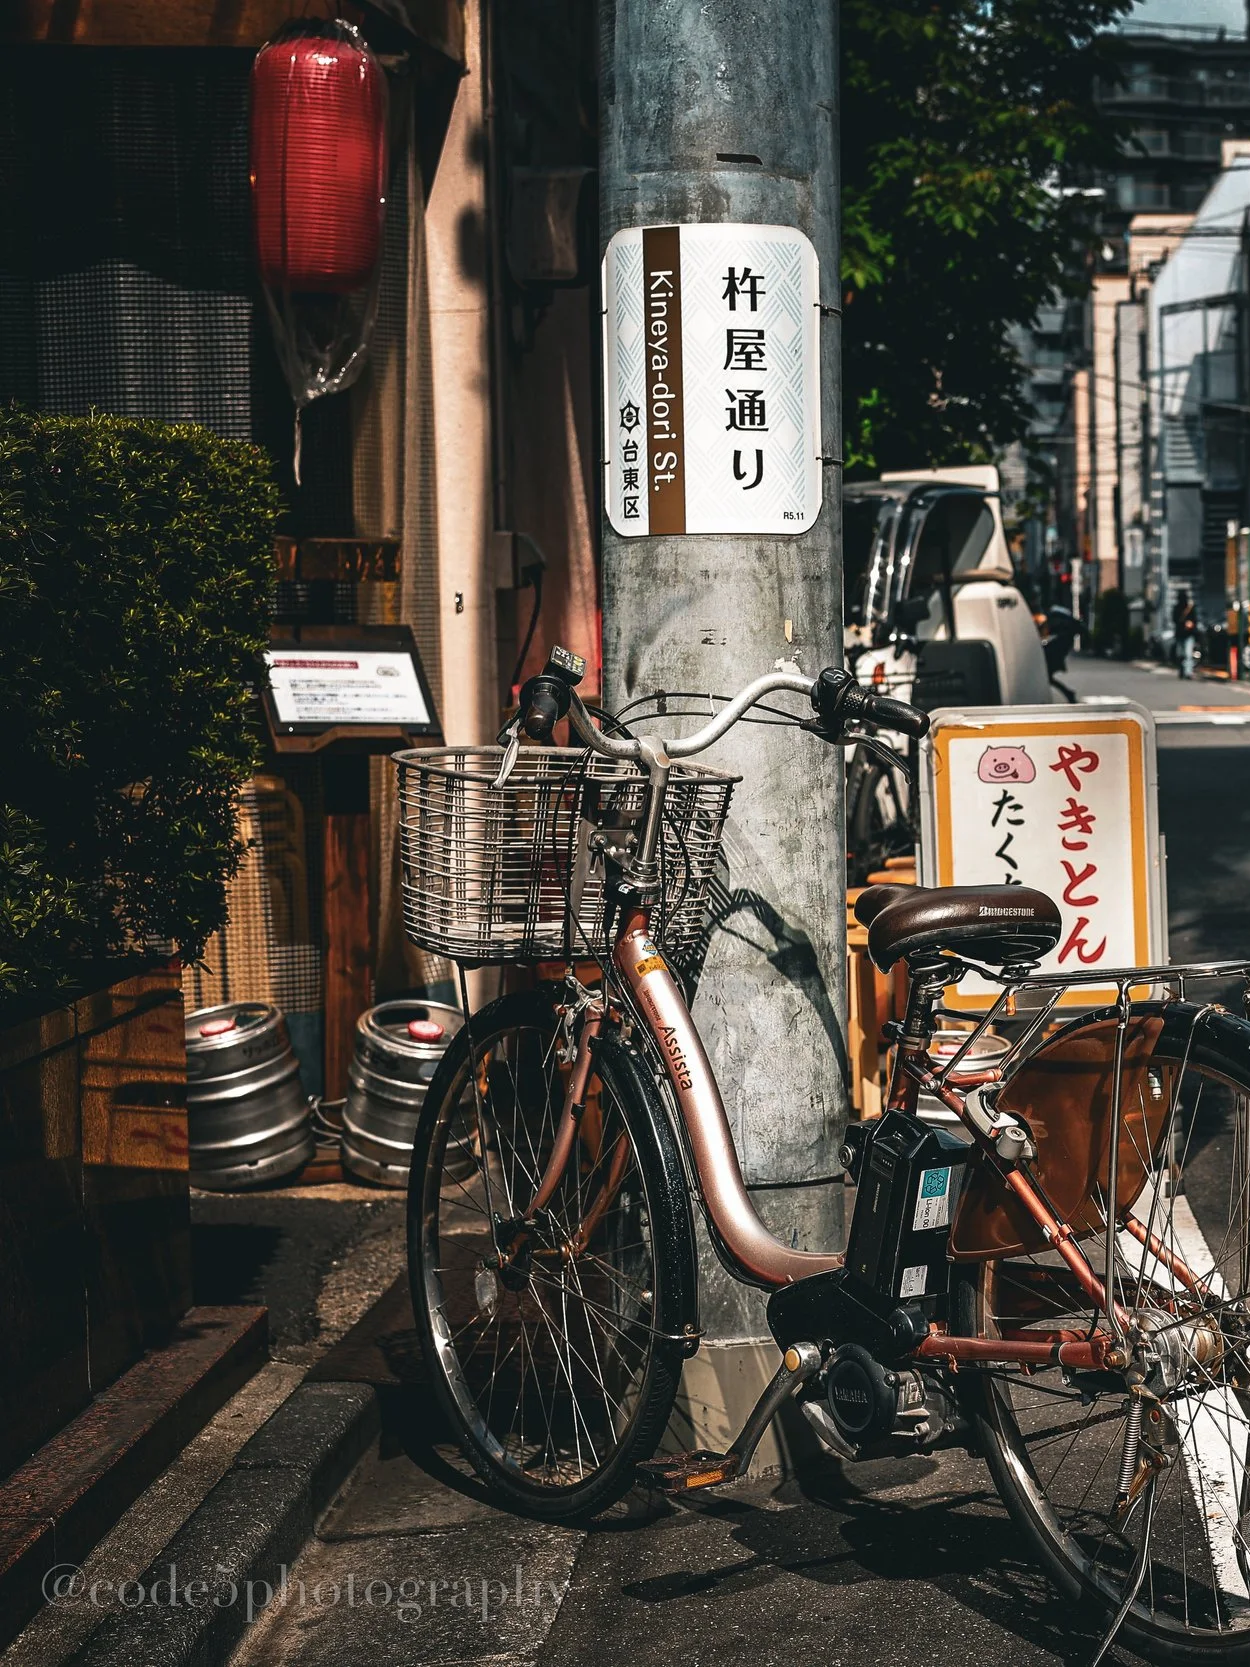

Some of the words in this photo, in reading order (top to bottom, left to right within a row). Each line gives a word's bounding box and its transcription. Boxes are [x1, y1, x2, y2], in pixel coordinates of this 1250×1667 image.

[648, 270, 676, 440] Kineya-dori
[722, 266, 769, 491] 杵屋通り
[622, 439, 640, 519] 台東区
[653, 451, 678, 492] St.
[783, 512, 804, 520] R5.11
[992, 789, 1025, 886] たく
[1049, 743, 1106, 965] やきとん
[979, 906, 1035, 917] BRIDGESTONE
[658, 1026, 693, 1091] Assista
